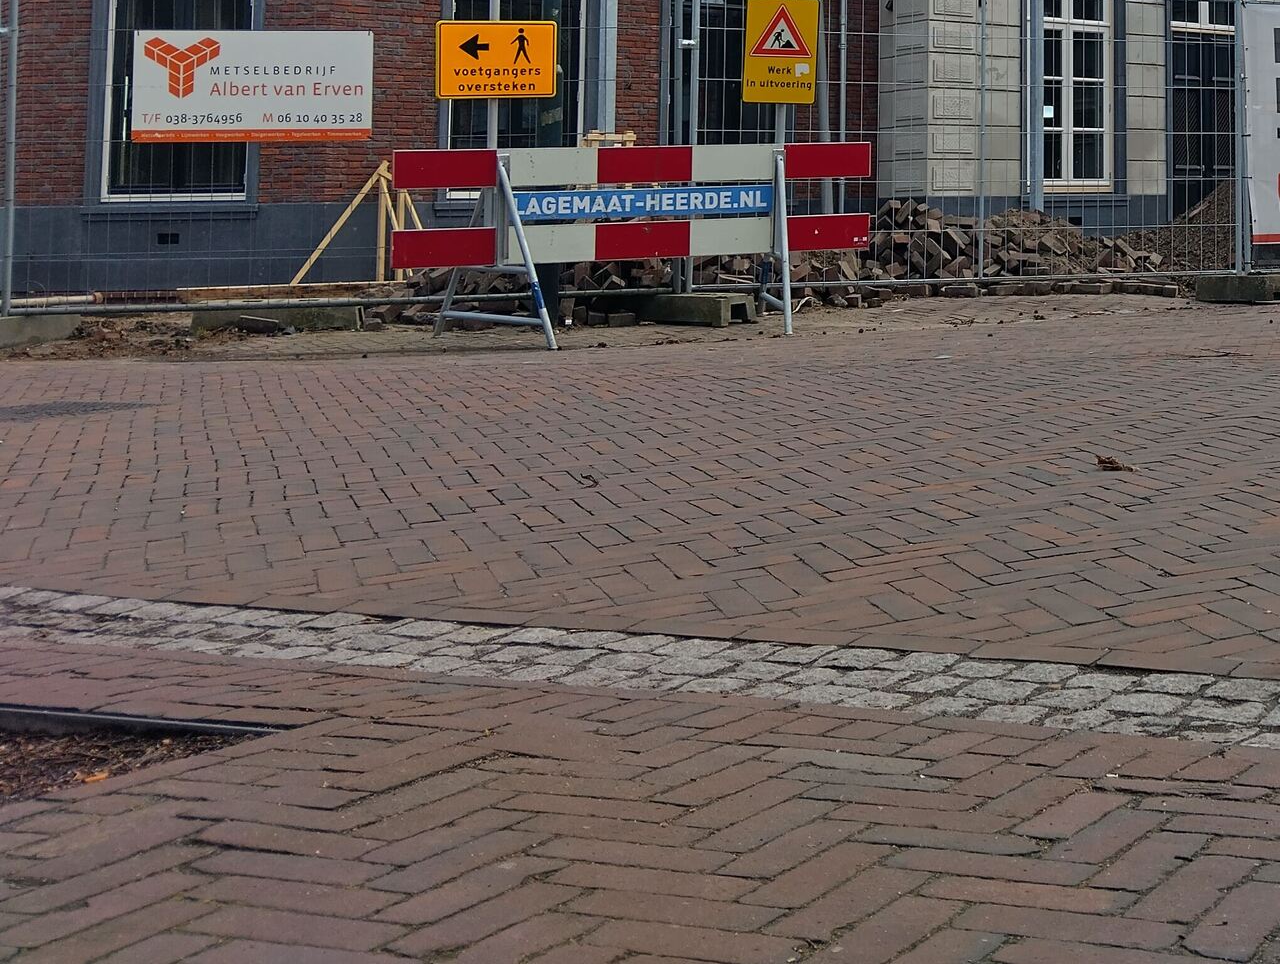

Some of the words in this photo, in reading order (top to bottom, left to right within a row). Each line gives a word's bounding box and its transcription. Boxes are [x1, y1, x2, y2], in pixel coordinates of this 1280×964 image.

[210, 65, 336, 76] METSELBEDRIJF
[453, 66, 542, 79] voetgangers
[767, 66, 792, 75] Werk
[209, 82, 267, 97] Albert
[273, 84, 306, 97] van
[313, 82, 364, 97] Erven
[458, 81, 536, 92] oversteken
[759, 79, 812, 90] uitvoering
[142, 113, 161, 125] T/F
[165, 112, 243, 126] 038-3764956
[262, 113, 273, 123] M
[277, 112, 291, 123] 06
[295, 114, 309, 123] 10
[313, 113, 327, 125] 40
[331, 114, 345, 125] 35
[349, 112, 363, 123] 28
[512, 190, 768, 216] LAGEMAAT-HEERDE.NL
